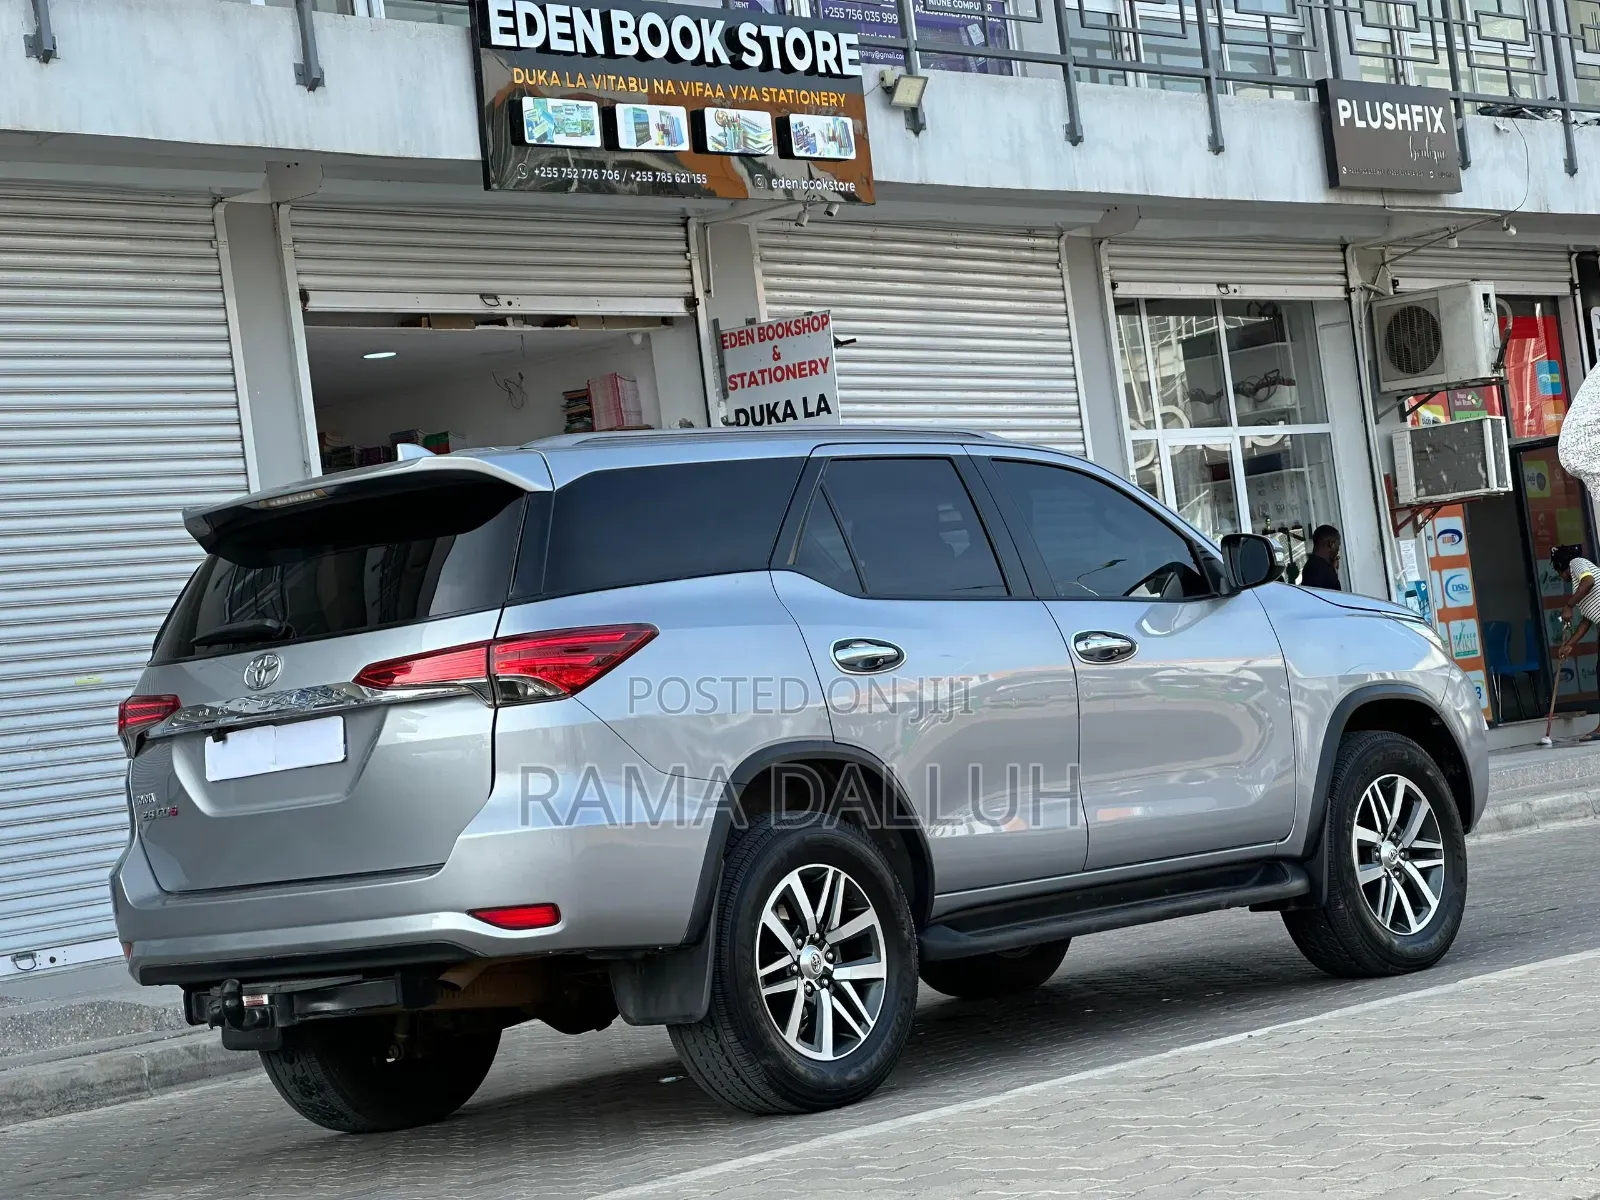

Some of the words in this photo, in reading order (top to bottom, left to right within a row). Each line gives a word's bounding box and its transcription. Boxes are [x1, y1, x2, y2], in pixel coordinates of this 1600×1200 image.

[824, 7, 845, 18] +255
[846, 9, 862, 20] 756
[864, 11, 880, 22] 035
[882, 12, 898, 24] 999
[488, 0, 603, 54] EDEN
[610, 9, 735, 65] BOOK
[741, 22, 862, 76] STORE
[513, 67, 562, 87] DUKA
[565, 71, 588, 89] LA
[591, 73, 650, 93] VITABU
[653, 78, 676, 96] NA
[679, 80, 725, 98] VIFAA
[729, 84, 760, 101] VYA
[761, 85, 847, 107] STATIONERY
[1337, 98, 1447, 134] PLUSHFIX
[534, 167, 558, 178] +255
[561, 168, 579, 179] 752
[581, 169, 599, 180] 776
[601, 169, 620, 181] 706
[622, 169, 628, 182] /
[630, 171, 653, 182] +255
[655, 171, 672, 183] 785
[675, 172, 690, 183] 621
[692, 173, 707, 184] 155
[771, 177, 856, 191] eden.bookstore
[721, 331, 755, 350] EDEN
[757, 315, 829, 342] BOOKSHOP
[772, 345, 781, 362] &
[728, 357, 830, 391] STATIONERY
[734, 399, 798, 427] DUKA
[802, 393, 832, 419] LA
